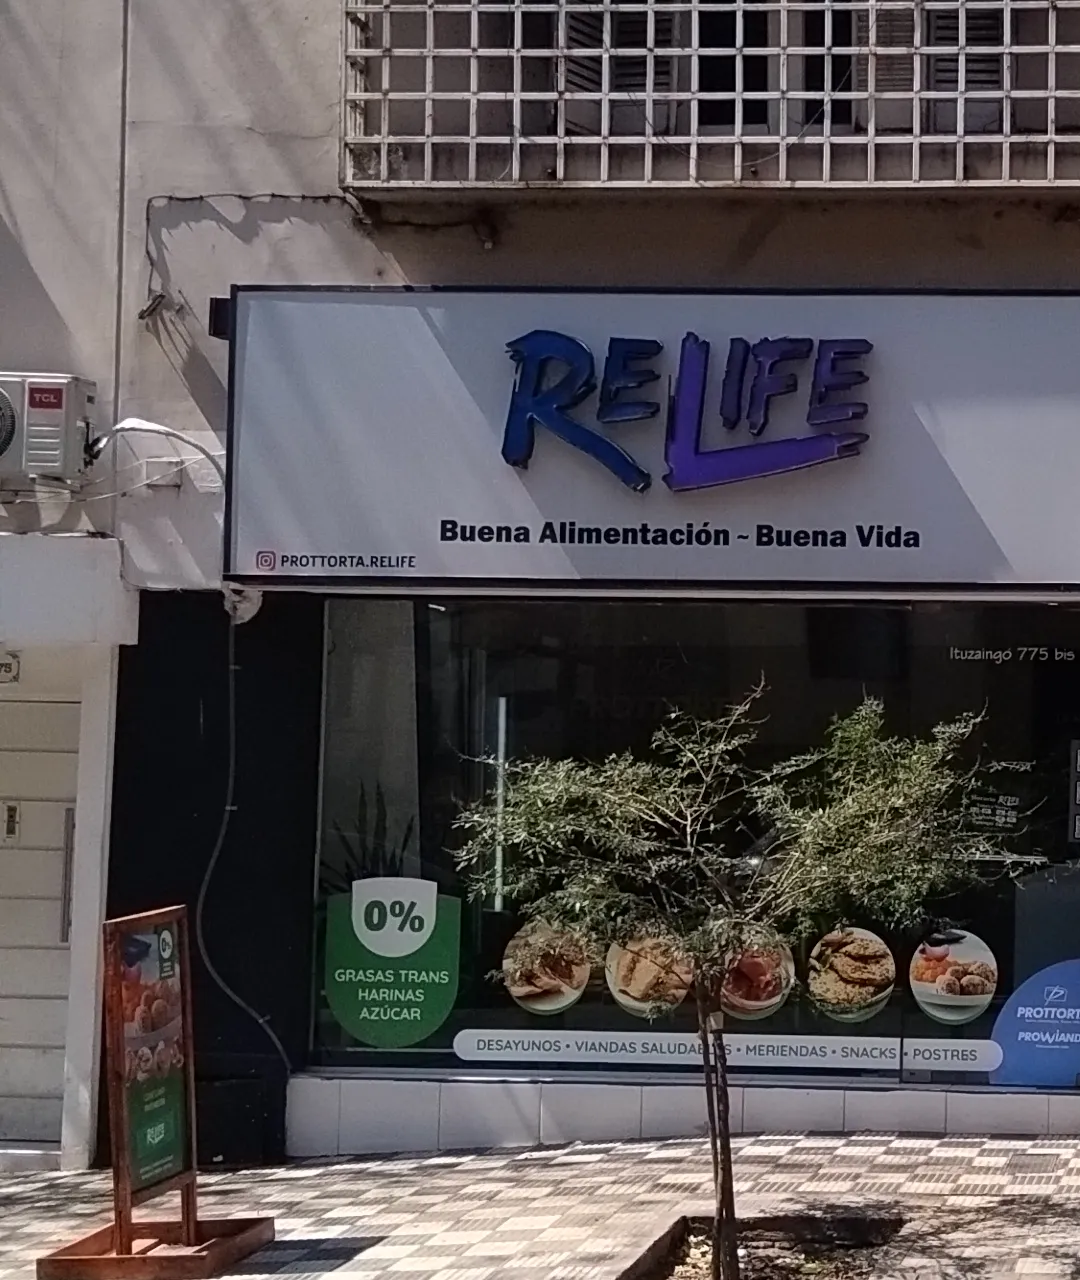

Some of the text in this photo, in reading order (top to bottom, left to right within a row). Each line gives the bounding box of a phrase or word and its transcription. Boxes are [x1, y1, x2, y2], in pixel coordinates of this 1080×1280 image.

[33, 392, 58, 403] TCL
[502, 329, 873, 493] RELIFE
[440, 520, 530, 543] Buena
[539, 521, 730, 546] Alimentación
[756, 524, 847, 548] Buena
[855, 524, 921, 548] Vida
[280, 554, 417, 569] PROTTORTA.RELIFE
[950, 646, 1076, 664] Ituzaingó 775 bis
[364, 899, 425, 932] 0%
[335, 969, 449, 983] GRASAS TRANS
[358, 988, 425, 1001] HARINAS
[359, 1004, 421, 1020] AZÚCAR
[476, 1038, 978, 1061] DESAYUNOS VIANDAS SALUDABS MERIENDAS SNACKS POSTRES
